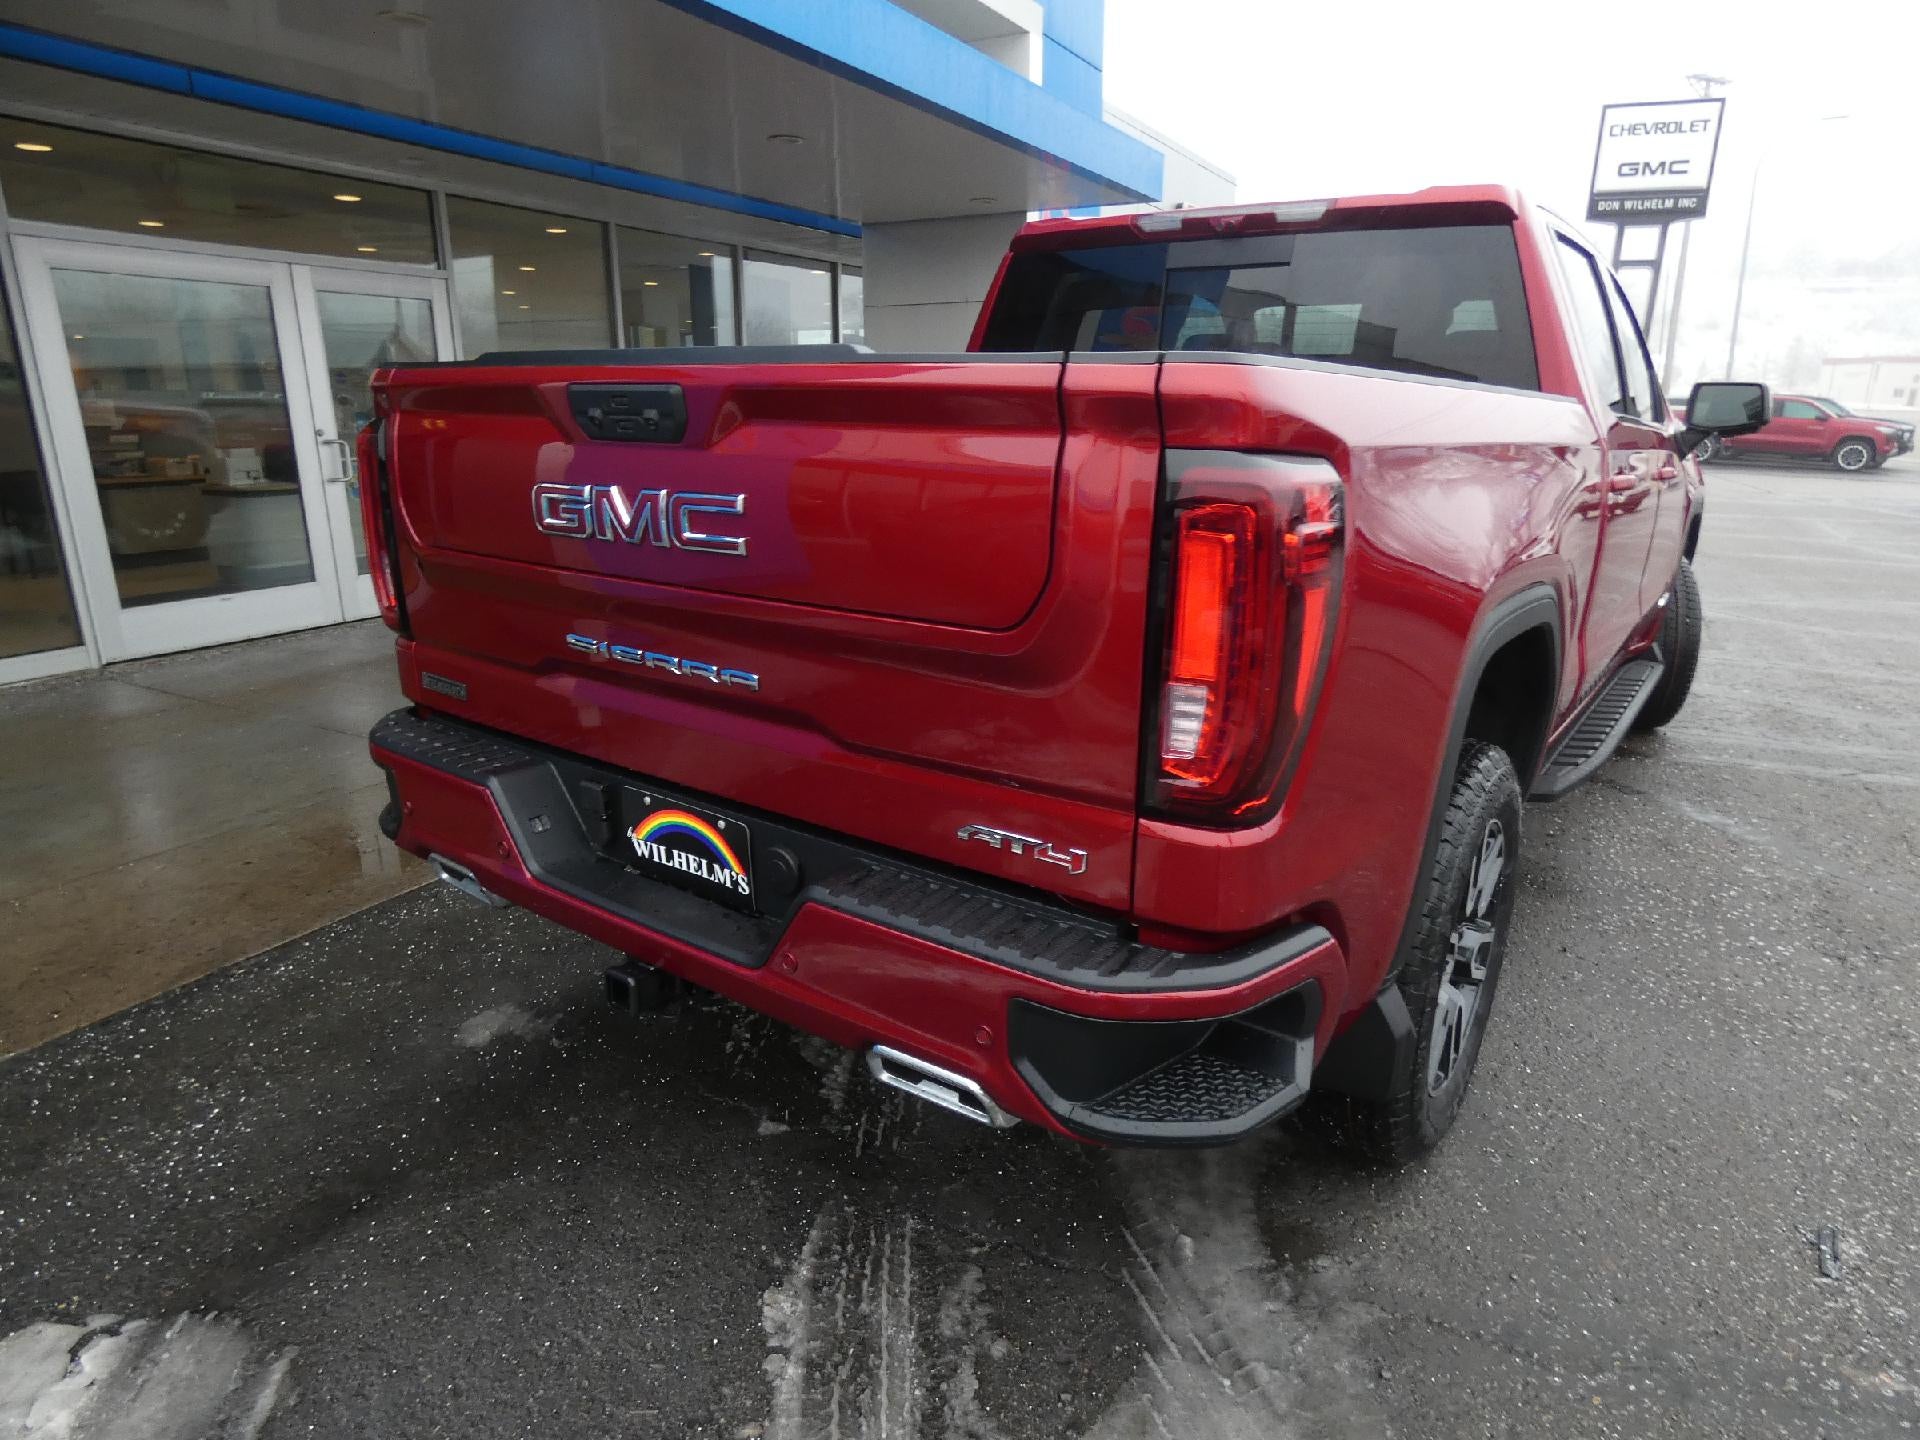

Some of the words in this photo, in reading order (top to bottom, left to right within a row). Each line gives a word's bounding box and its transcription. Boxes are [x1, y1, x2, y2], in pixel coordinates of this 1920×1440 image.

[1609, 119, 1711, 137] CHEVROLET
[1617, 160, 1690, 177] GMC
[1597, 201, 1619, 211] DON
[1624, 198, 1674, 210] WILHELM
[1677, 197, 1697, 208] INC
[531, 482, 748, 556] GMC
[565, 633, 760, 691] SIERRA
[632, 838, 750, 895] WILHELM'S
[957, 823, 1088, 875] AT4
